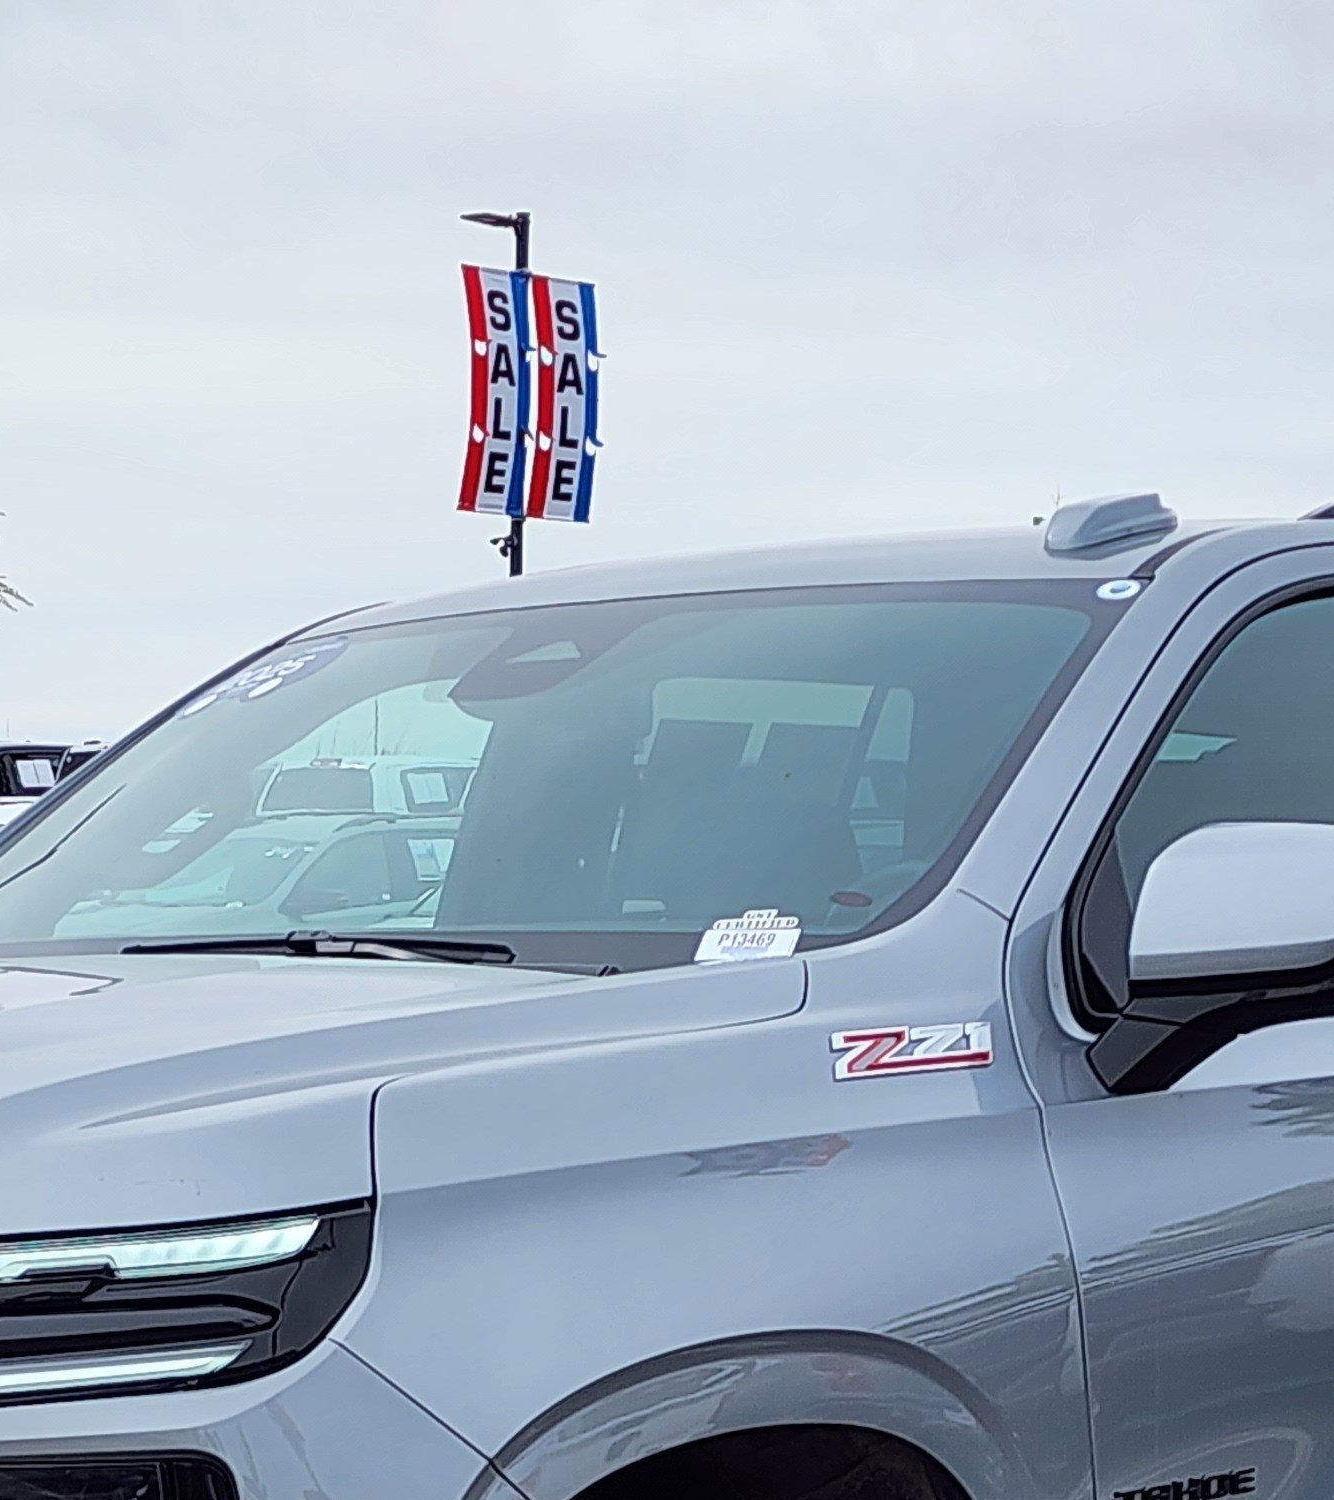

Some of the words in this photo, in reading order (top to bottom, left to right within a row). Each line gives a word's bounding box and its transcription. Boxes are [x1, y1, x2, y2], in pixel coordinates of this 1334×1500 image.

[483, 290, 516, 494] SALE
[551, 299, 584, 502] SALE
[717, 933, 776, 947] P13469
[830, 1021, 994, 1082] Z71
